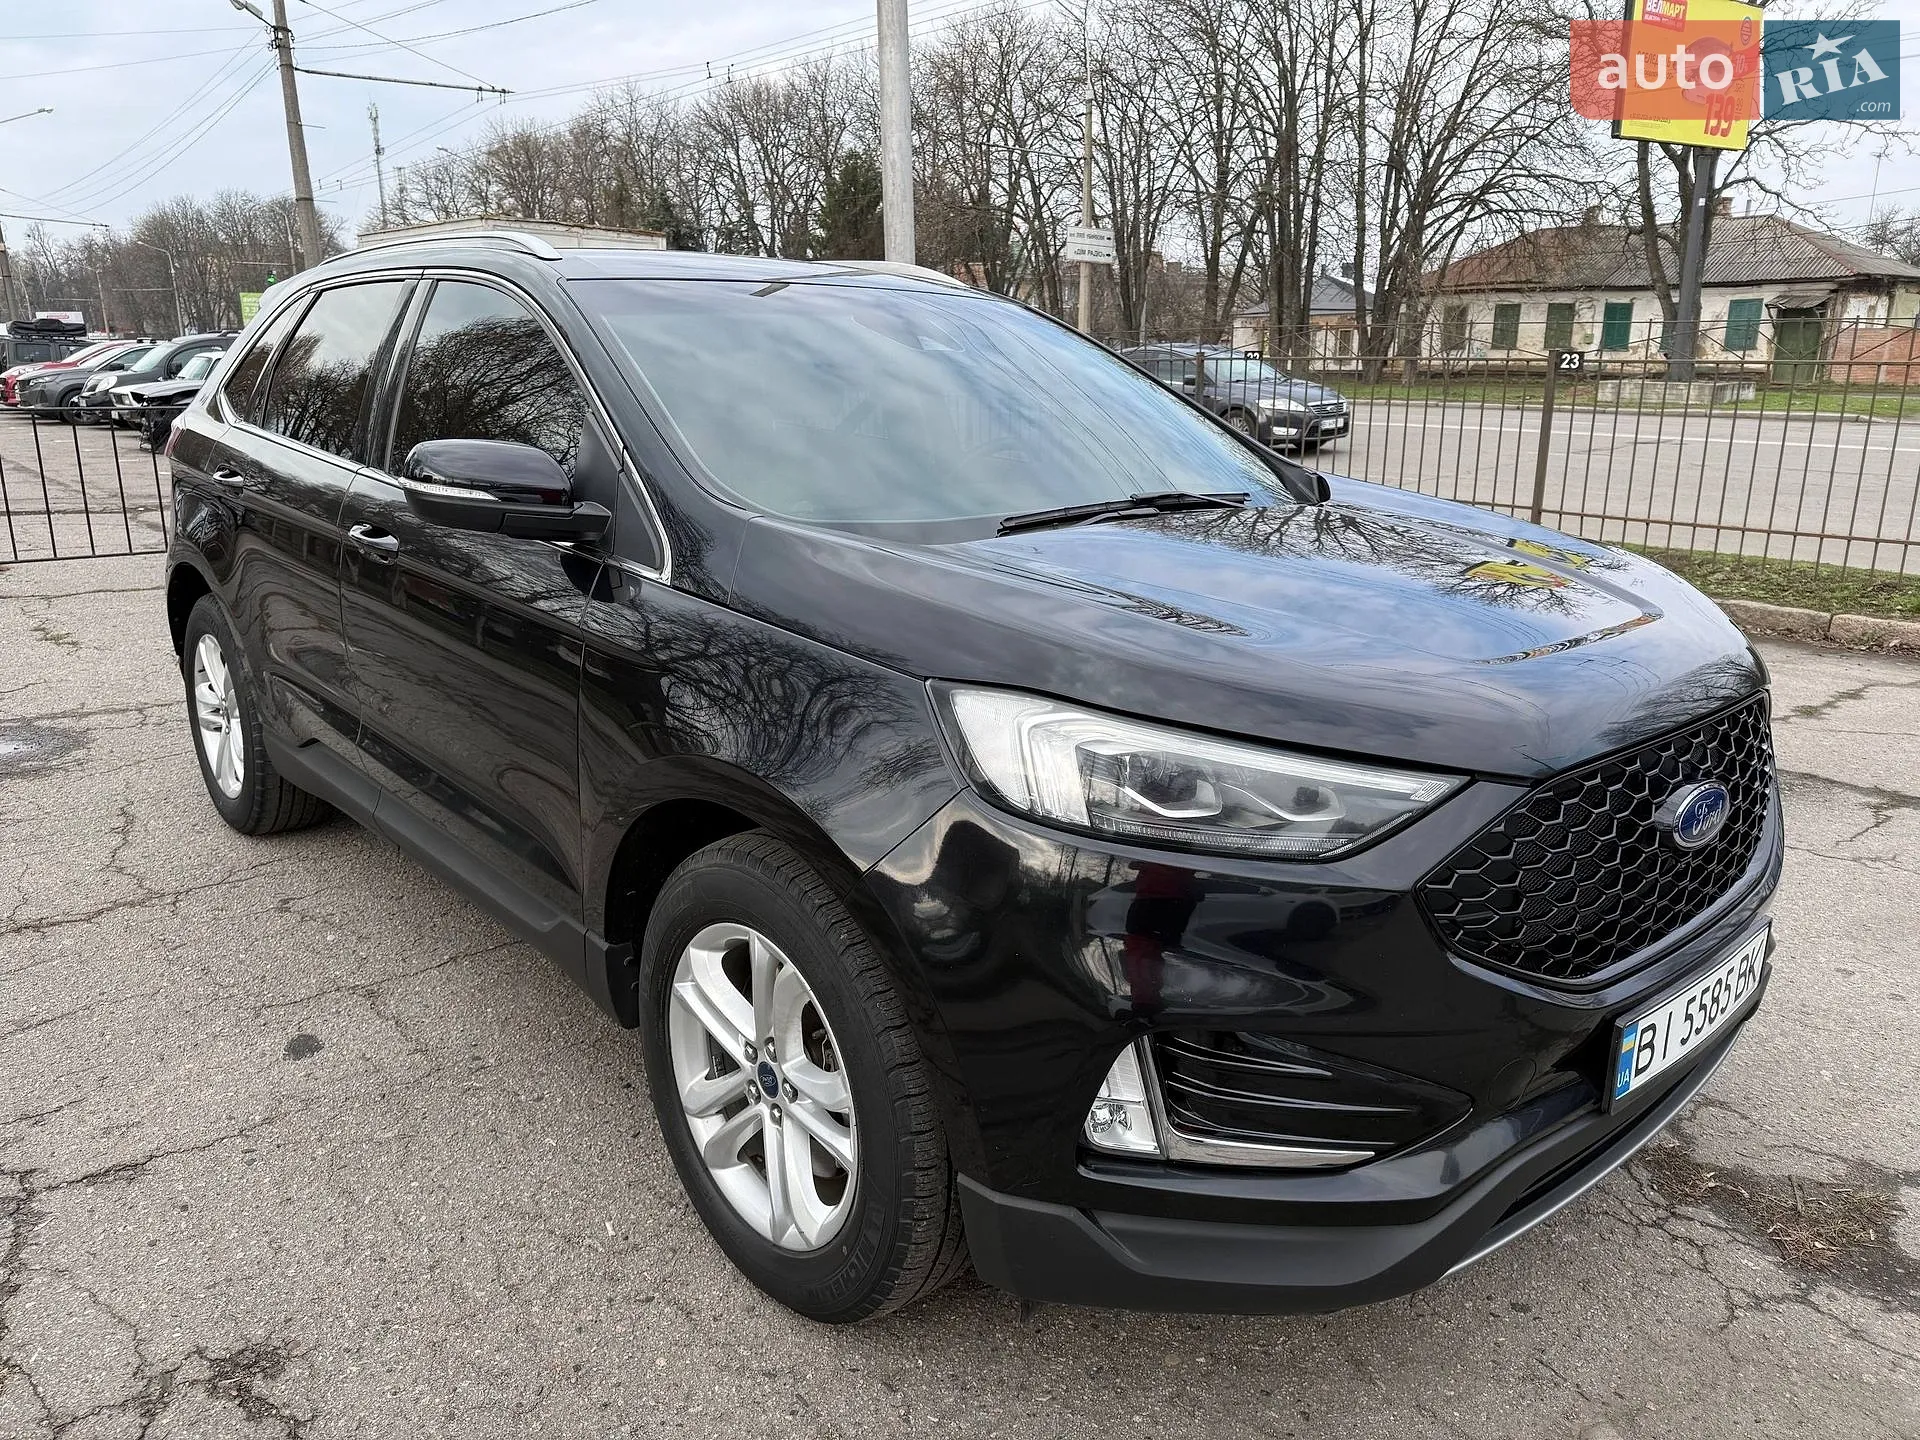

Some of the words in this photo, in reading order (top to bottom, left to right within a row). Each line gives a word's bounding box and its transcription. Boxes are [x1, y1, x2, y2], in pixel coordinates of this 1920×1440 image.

[1704, 93, 1735, 137] 139
[1560, 353, 1580, 369] 23
[1692, 796, 1722, 836] Ford
[1634, 1010, 1673, 1079] BI
[1680, 965, 1735, 1046] 5585
[1735, 938, 1765, 1003] BK
[1617, 1072, 1630, 1088] UA
